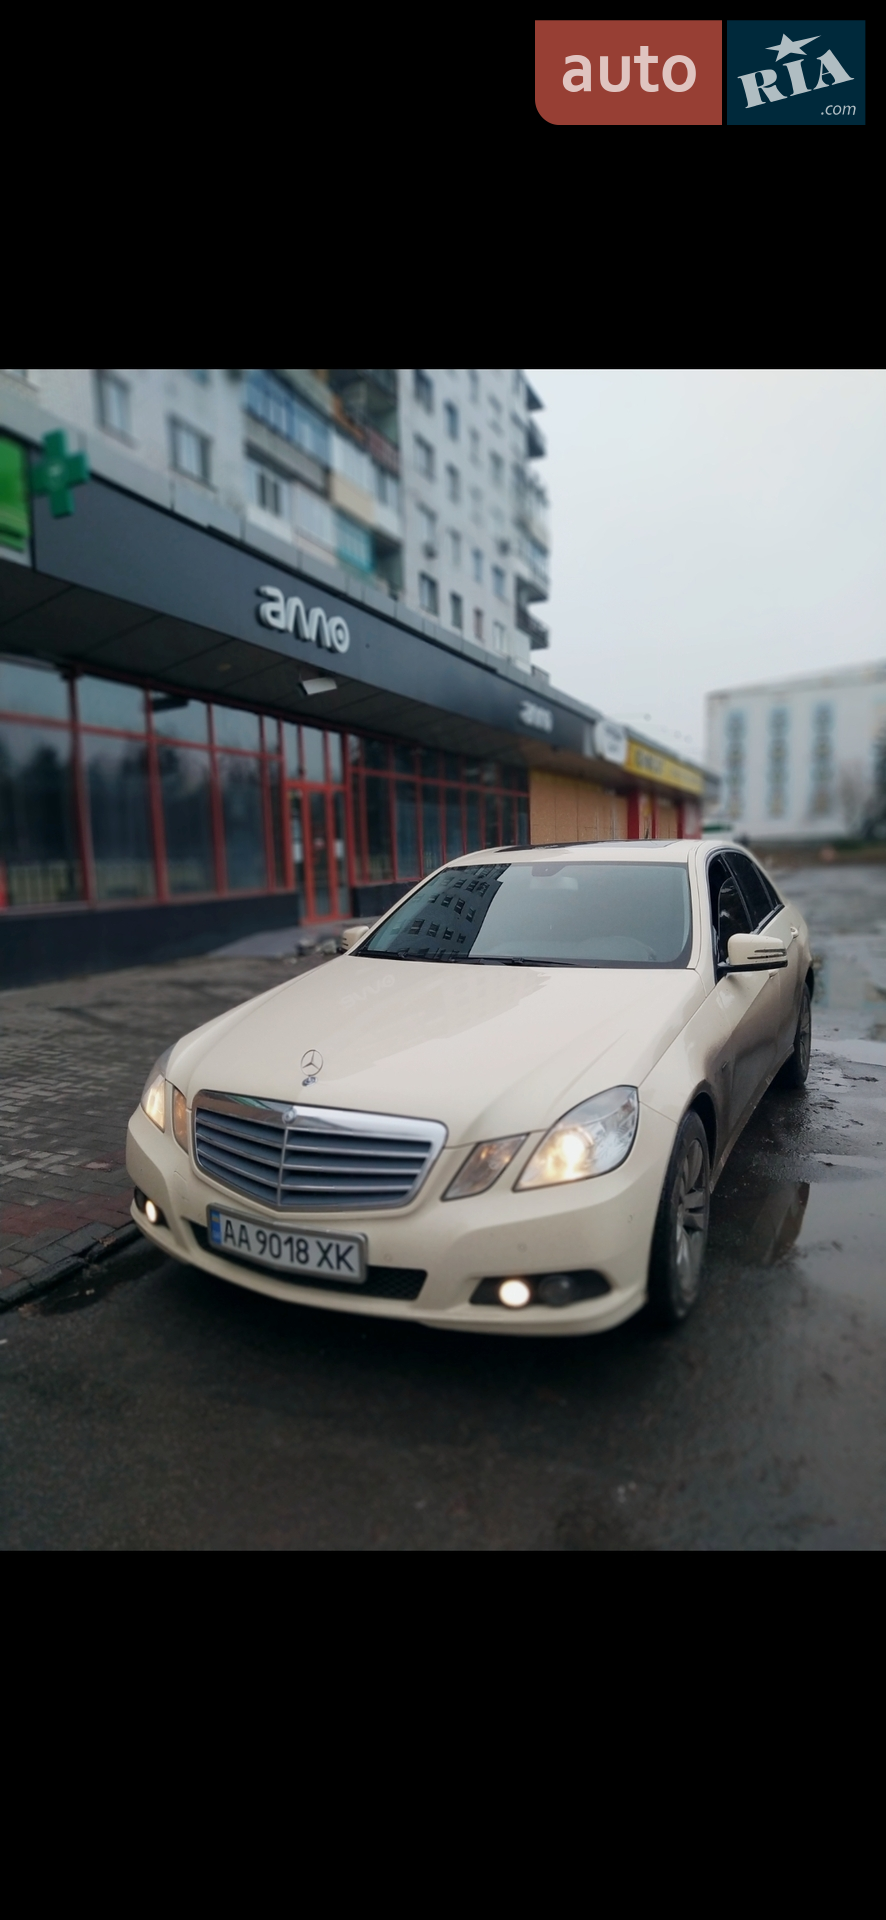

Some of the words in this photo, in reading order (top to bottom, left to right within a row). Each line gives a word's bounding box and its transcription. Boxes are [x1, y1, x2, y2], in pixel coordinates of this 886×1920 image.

[223, 1219, 251, 1251] AA
[255, 1229, 310, 1265] 9018
[315, 1240, 355, 1272] XK
